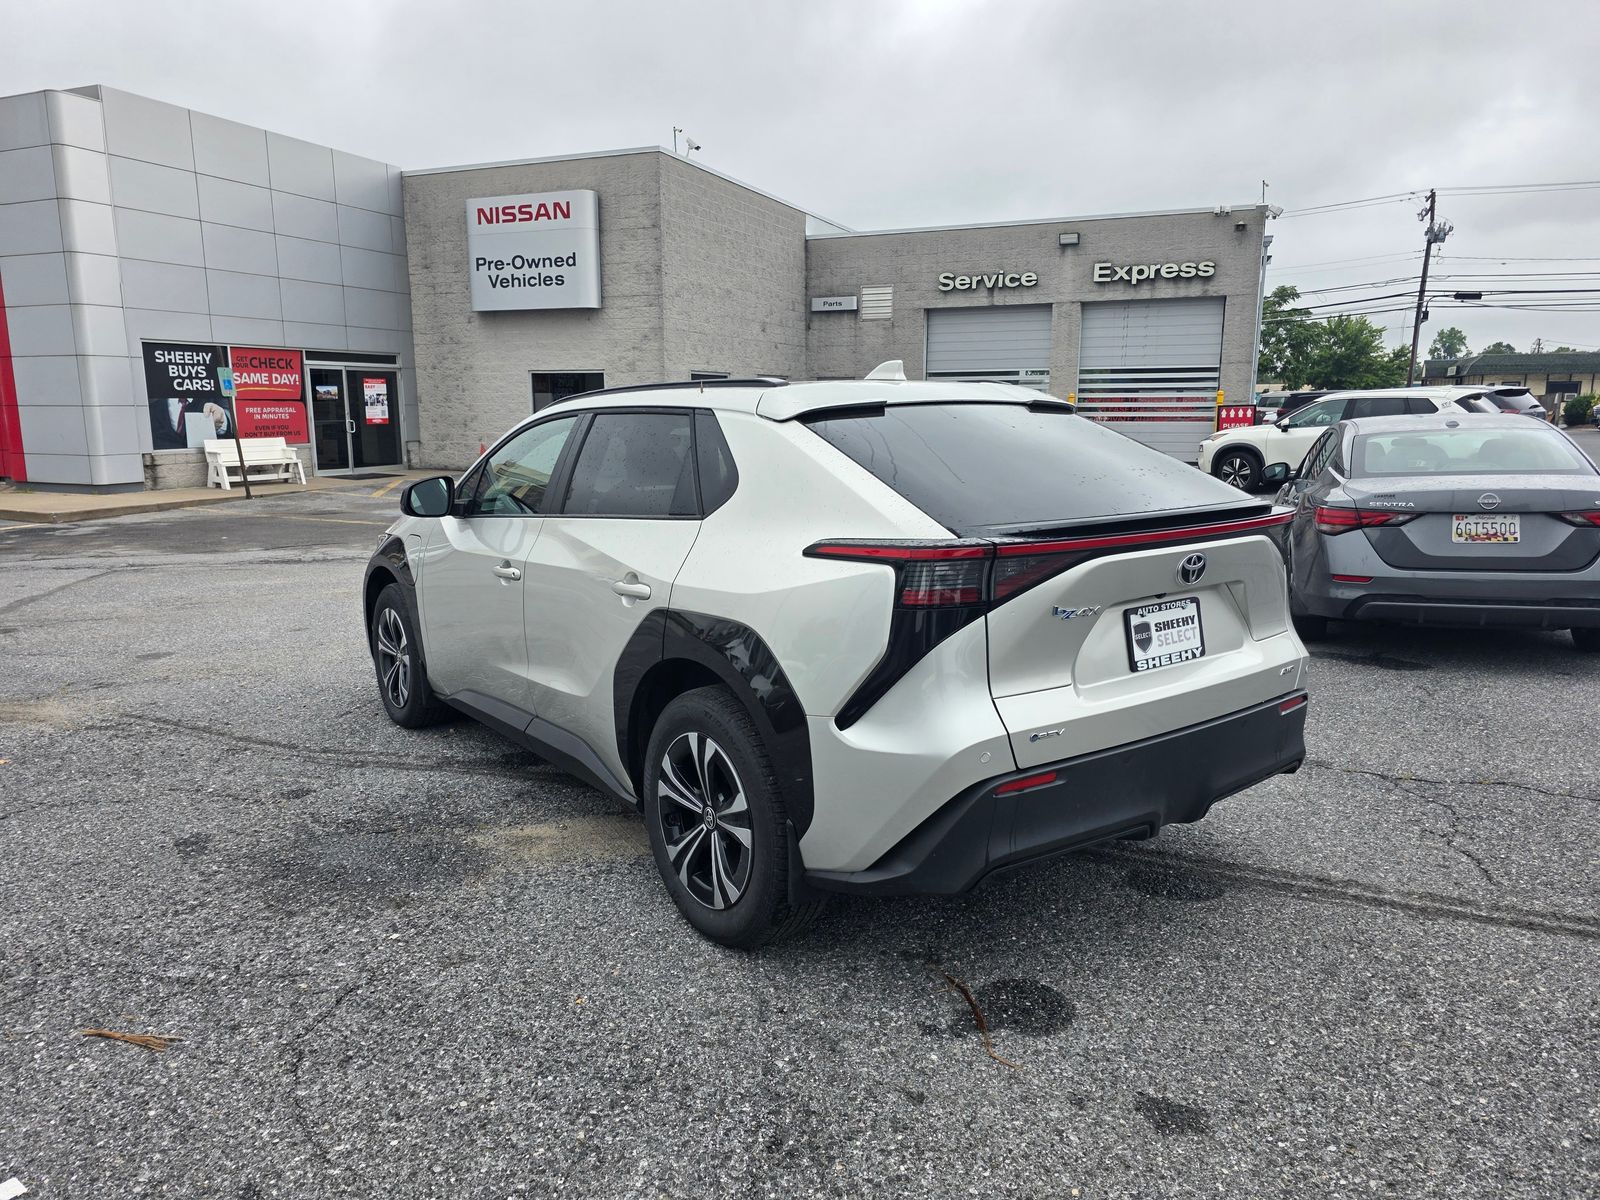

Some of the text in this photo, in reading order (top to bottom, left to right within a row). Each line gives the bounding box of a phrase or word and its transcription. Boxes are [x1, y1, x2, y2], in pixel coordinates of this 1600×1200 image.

[476, 201, 571, 226] NISSAN
[475, 252, 577, 272] Pre-Owned
[488, 272, 565, 289] Vehicles
[938, 269, 1038, 291] Service
[1093, 260, 1216, 285] Express
[154, 350, 212, 364] SHEEHY
[249, 356, 294, 370] CHECK
[168, 365, 207, 377] BUYS
[233, 372, 300, 385] SAME DAY!
[173, 379, 215, 391] CARS!
[1455, 521, 1517, 537] 6GT5500
[1137, 599, 1192, 615] AUTO STORES
[1154, 614, 1196, 633] SHEEHY
[1134, 631, 1152, 641] SELECT
[1156, 627, 1198, 648] SELECT
[1136, 646, 1203, 671] SHEEHY
